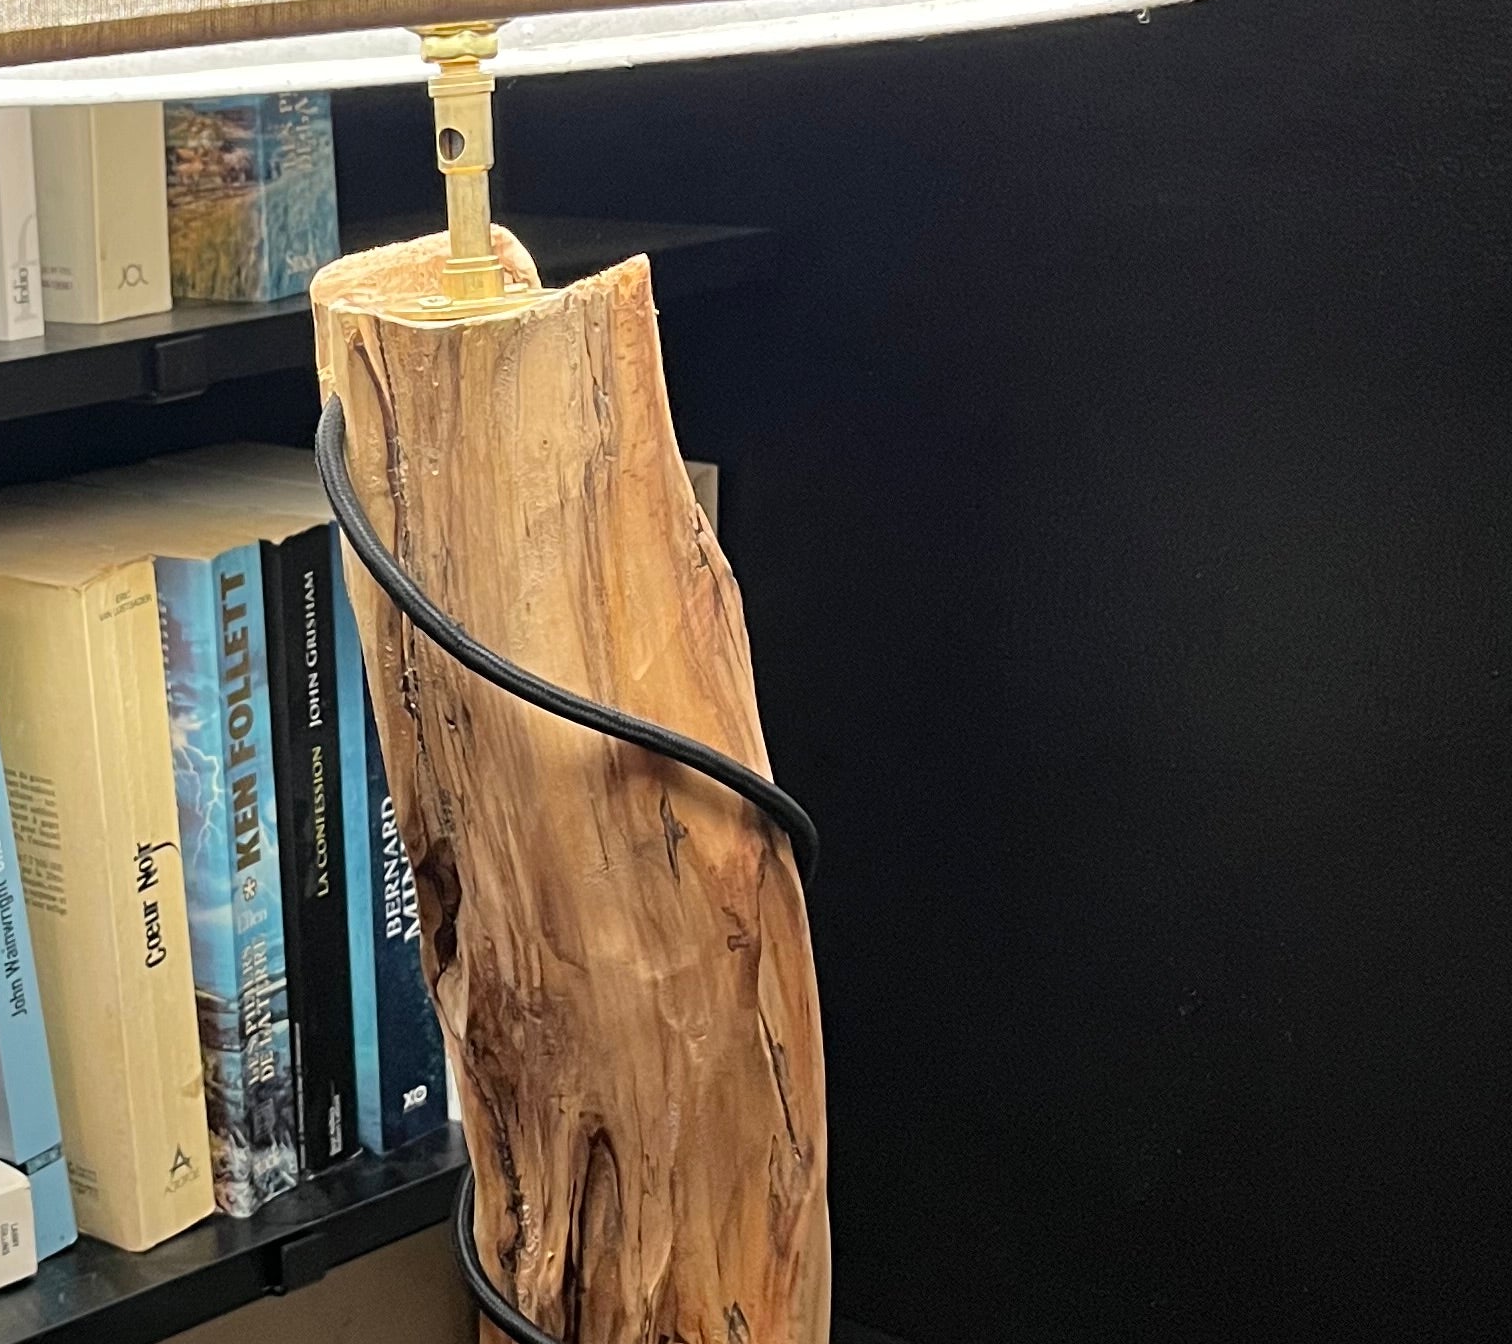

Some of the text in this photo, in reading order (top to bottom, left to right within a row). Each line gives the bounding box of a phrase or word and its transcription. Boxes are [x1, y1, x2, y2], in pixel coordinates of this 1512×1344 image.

[13, 267, 29, 305] folio
[302, 569, 324, 728] JOHN GRISHAM
[220, 571, 261, 872] KEN FOLLETT
[136, 841, 179, 896] Noir
[311, 745, 330, 898] LA CONFESSION
[381, 795, 403, 940] BERNARD
[10, 977, 29, 1017] John
[402, 1083, 429, 1112] XO
